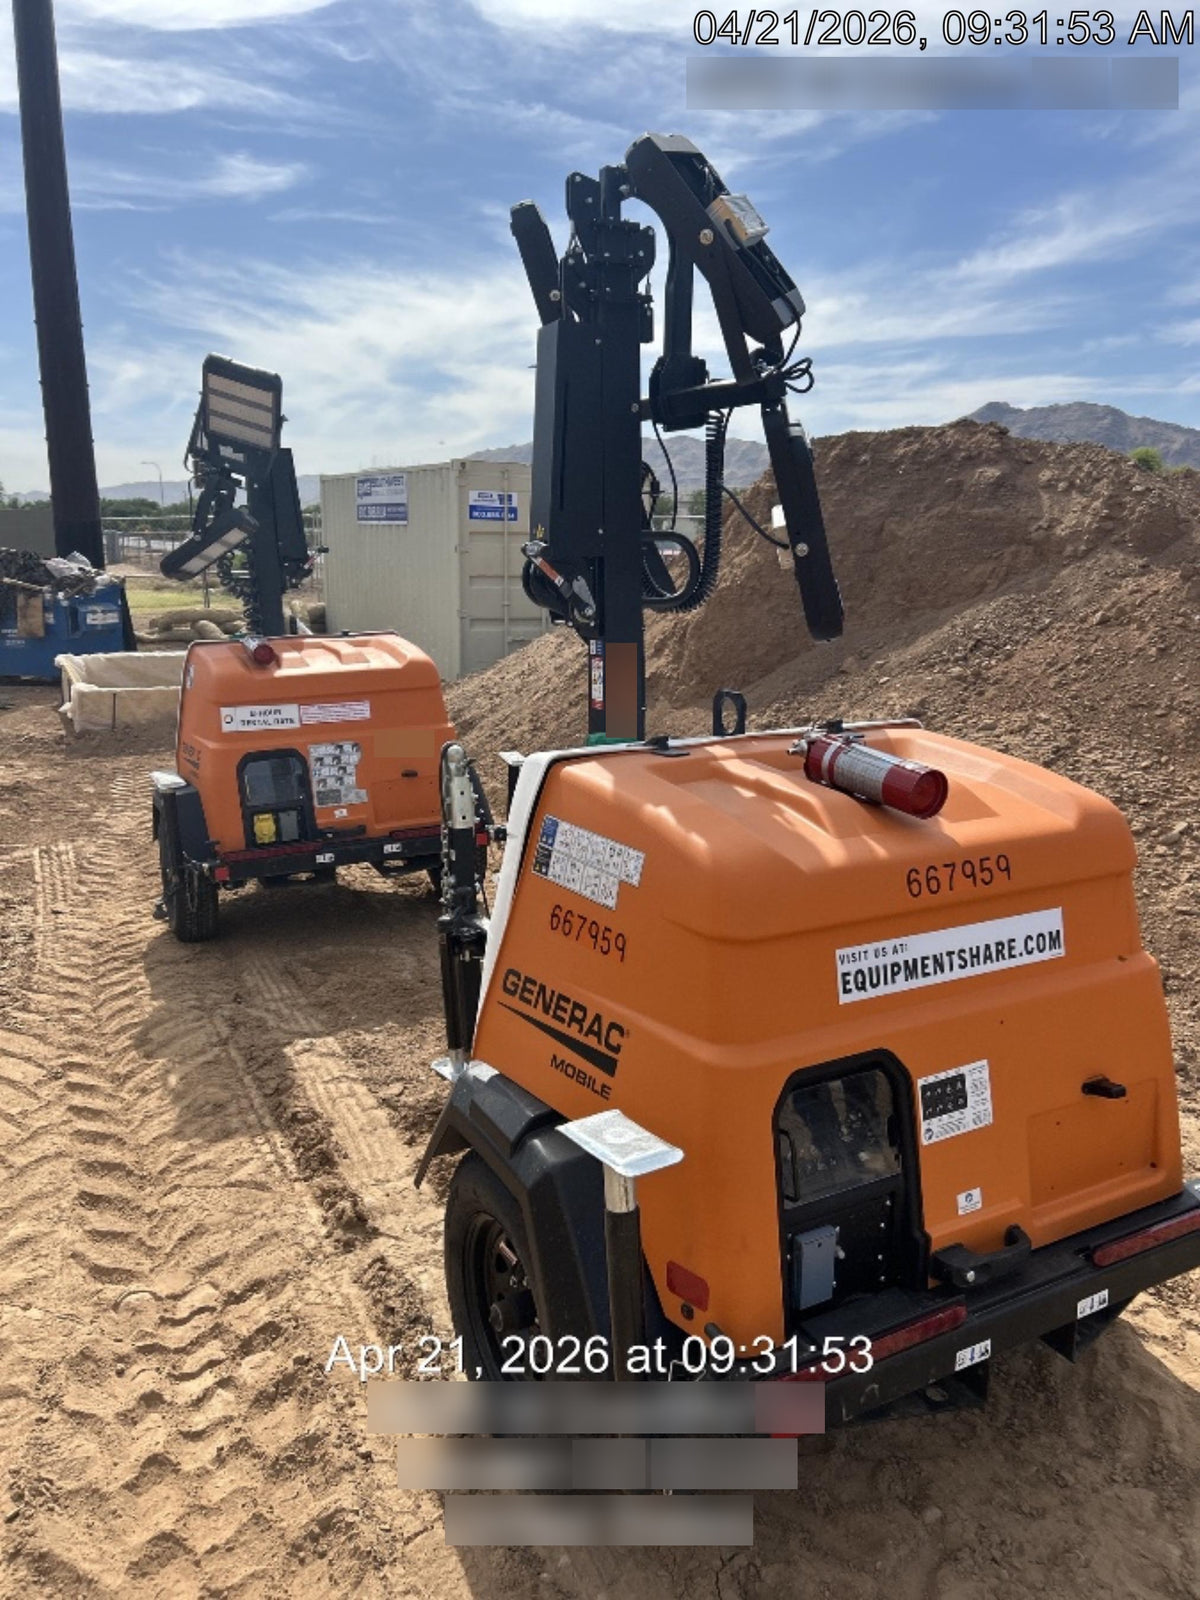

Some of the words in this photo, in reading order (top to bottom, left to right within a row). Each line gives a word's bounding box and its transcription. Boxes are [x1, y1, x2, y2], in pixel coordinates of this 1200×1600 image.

[906, 853, 1012, 898] 667959
[549, 903, 628, 963] 667959
[838, 949, 869, 966] VISIT
[874, 946, 888, 960] US
[892, 942, 908, 956] AT:
[840, 929, 1062, 995] EQUIPMENTSHARE.COM
[501, 967, 626, 1056] GENERAC
[549, 1053, 613, 1101] MOBILE
